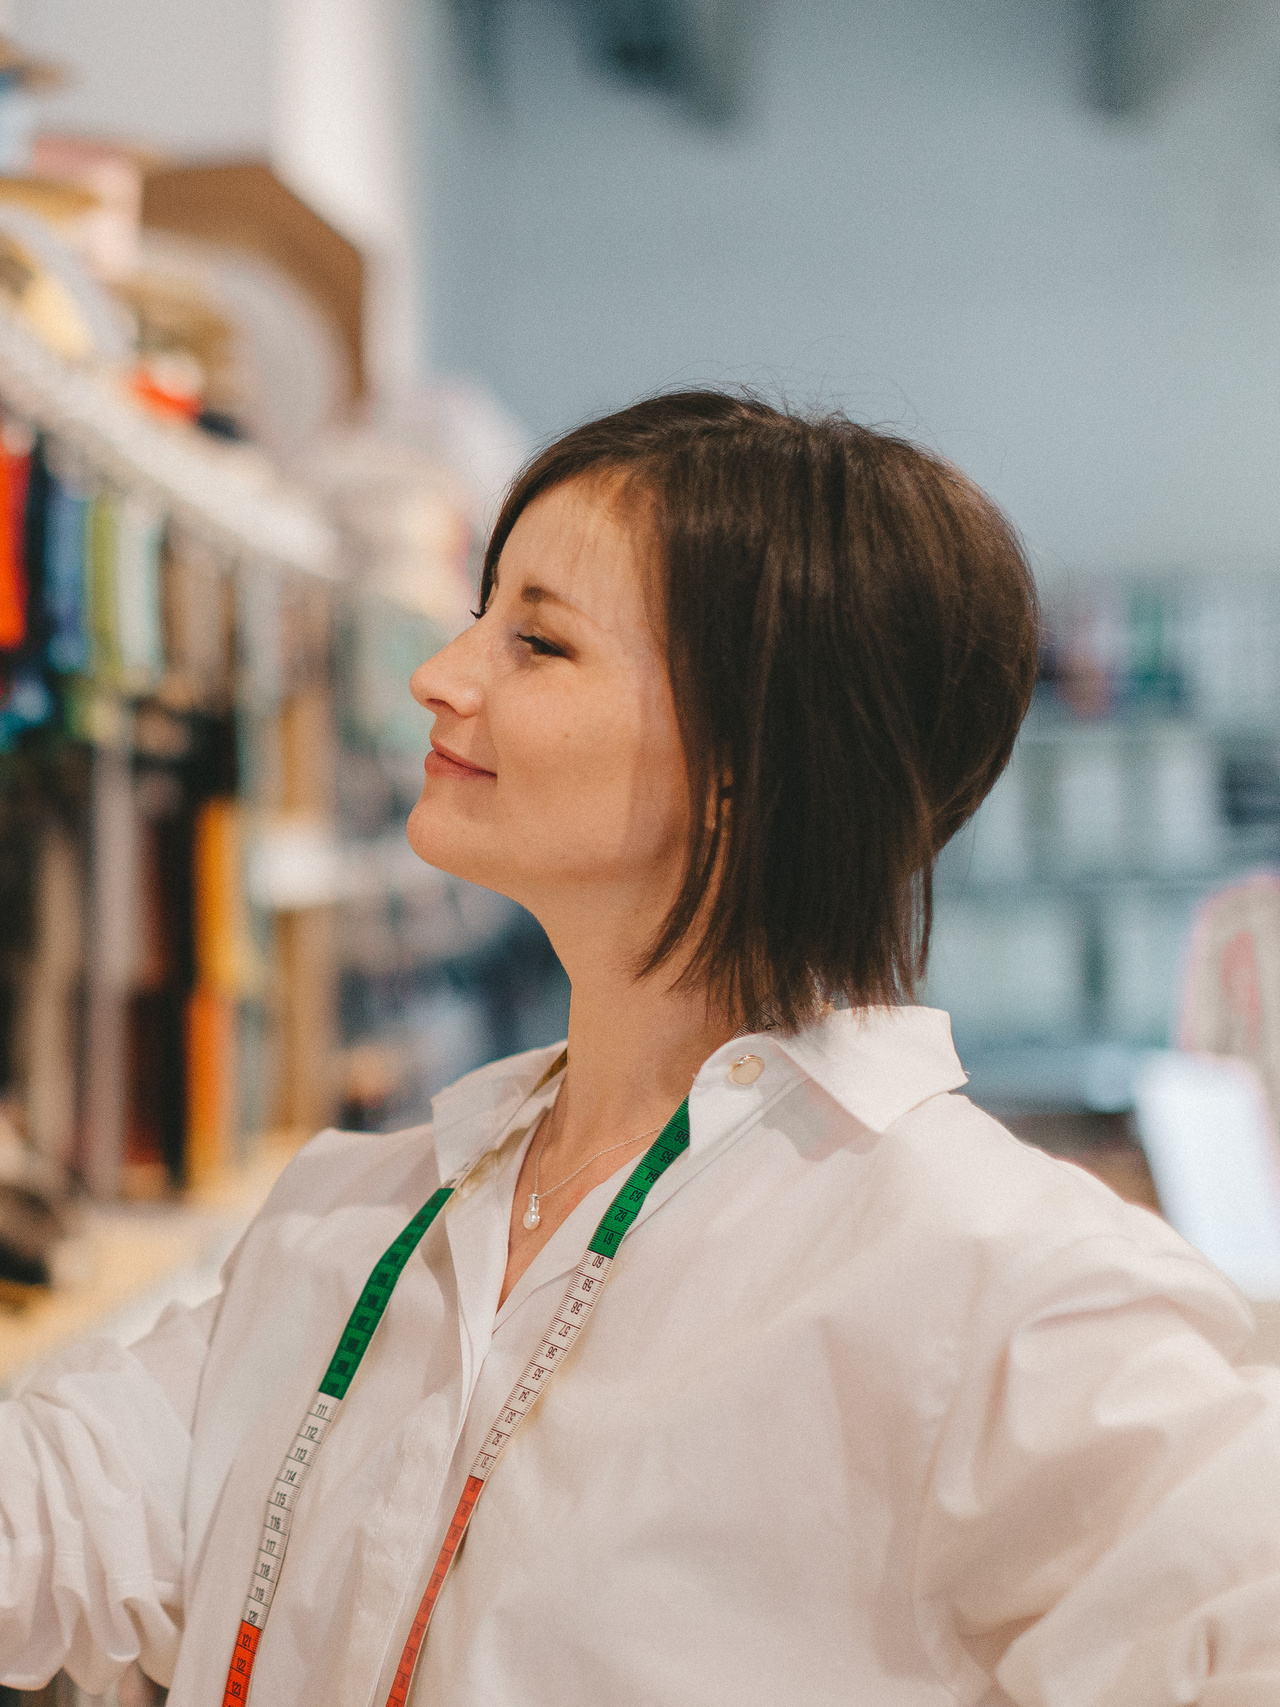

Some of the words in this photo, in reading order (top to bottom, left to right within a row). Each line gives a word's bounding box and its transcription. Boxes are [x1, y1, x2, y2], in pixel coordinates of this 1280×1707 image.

[316, 1403, 329, 1417] 111
[305, 1425, 319, 1439] 112
[295, 1447, 308, 1461] 113
[284, 1469, 297, 1483] 114
[275, 1491, 287, 1506] 115
[270, 1515, 282, 1530] 116
[265, 1538, 277, 1553] 117
[260, 1562, 271, 1578] 118
[255, 1586, 265, 1602] 119
[247, 1609, 259, 1625] 120
[242, 1633, 252, 1648] 121
[236, 1657, 247, 1673] 122
[231, 1681, 242, 1696] 123
